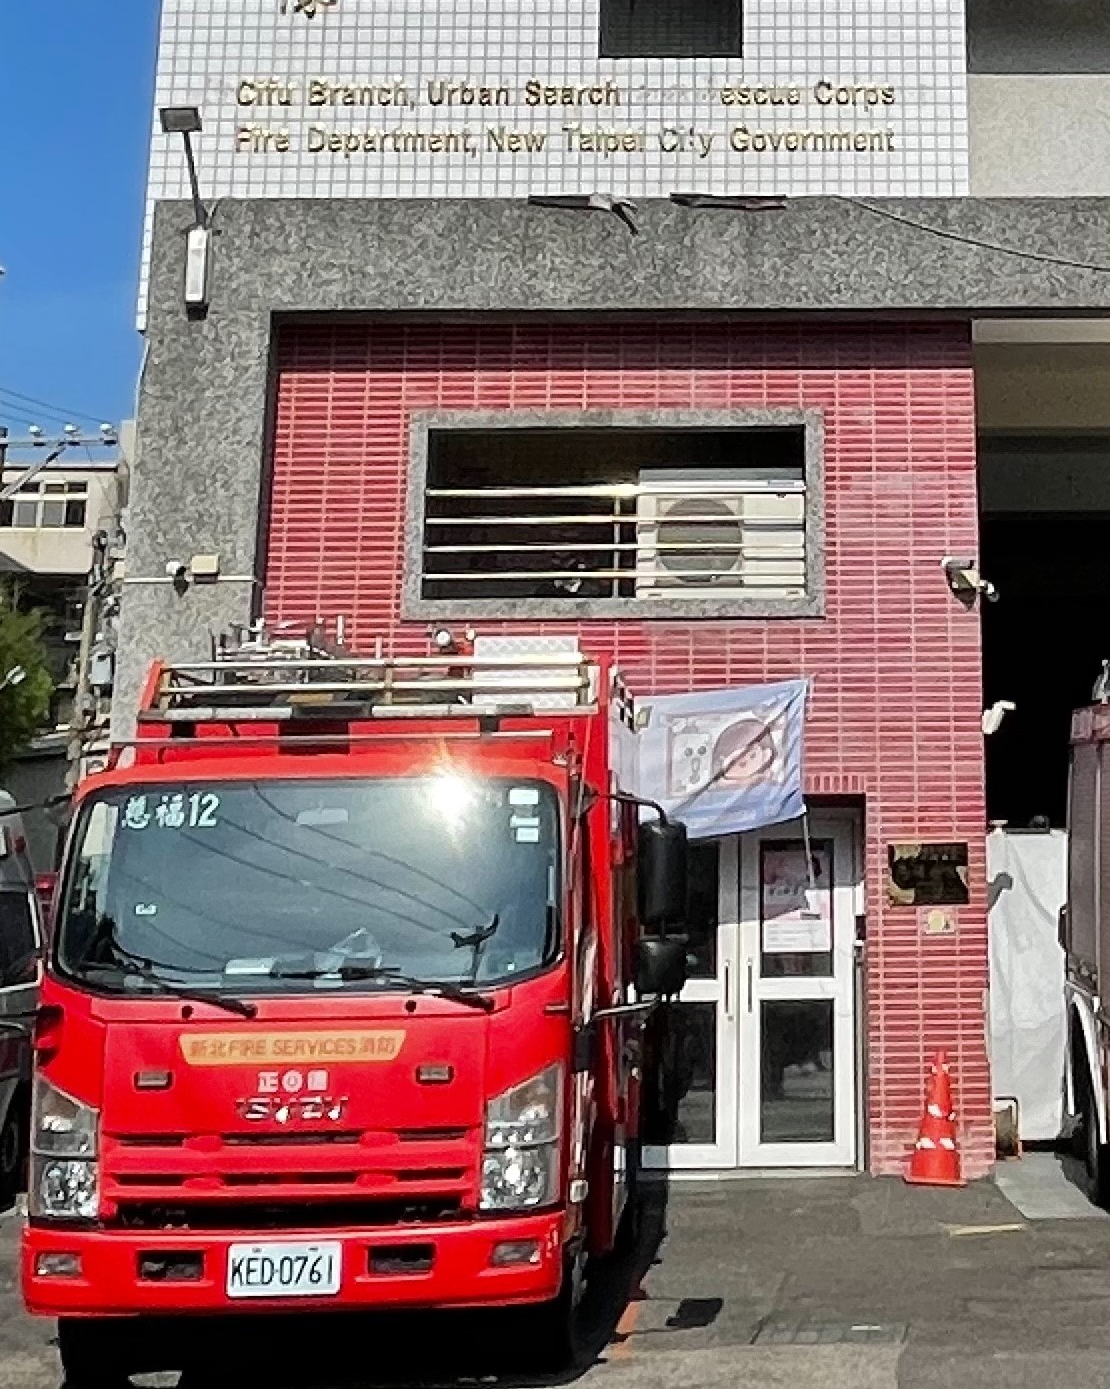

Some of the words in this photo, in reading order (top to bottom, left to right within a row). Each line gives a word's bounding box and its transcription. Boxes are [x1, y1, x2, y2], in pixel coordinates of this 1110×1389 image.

[236, 77, 293, 106] Cifu
[308, 76, 415, 111] Branch,
[427, 78, 509, 106] Urban
[525, 78, 620, 106] Search
[813, 78, 895, 112] Corps
[235, 124, 291, 152] Fire
[307, 124, 477, 158] Department,
[486, 124, 547, 152] New
[562, 124, 644, 158] Taipei
[658, 124, 714, 158] City
[730, 123, 896, 152] Government
[272, 1037, 358, 1056] SERVICES
[231, 1255, 334, 1287] KED-0761
